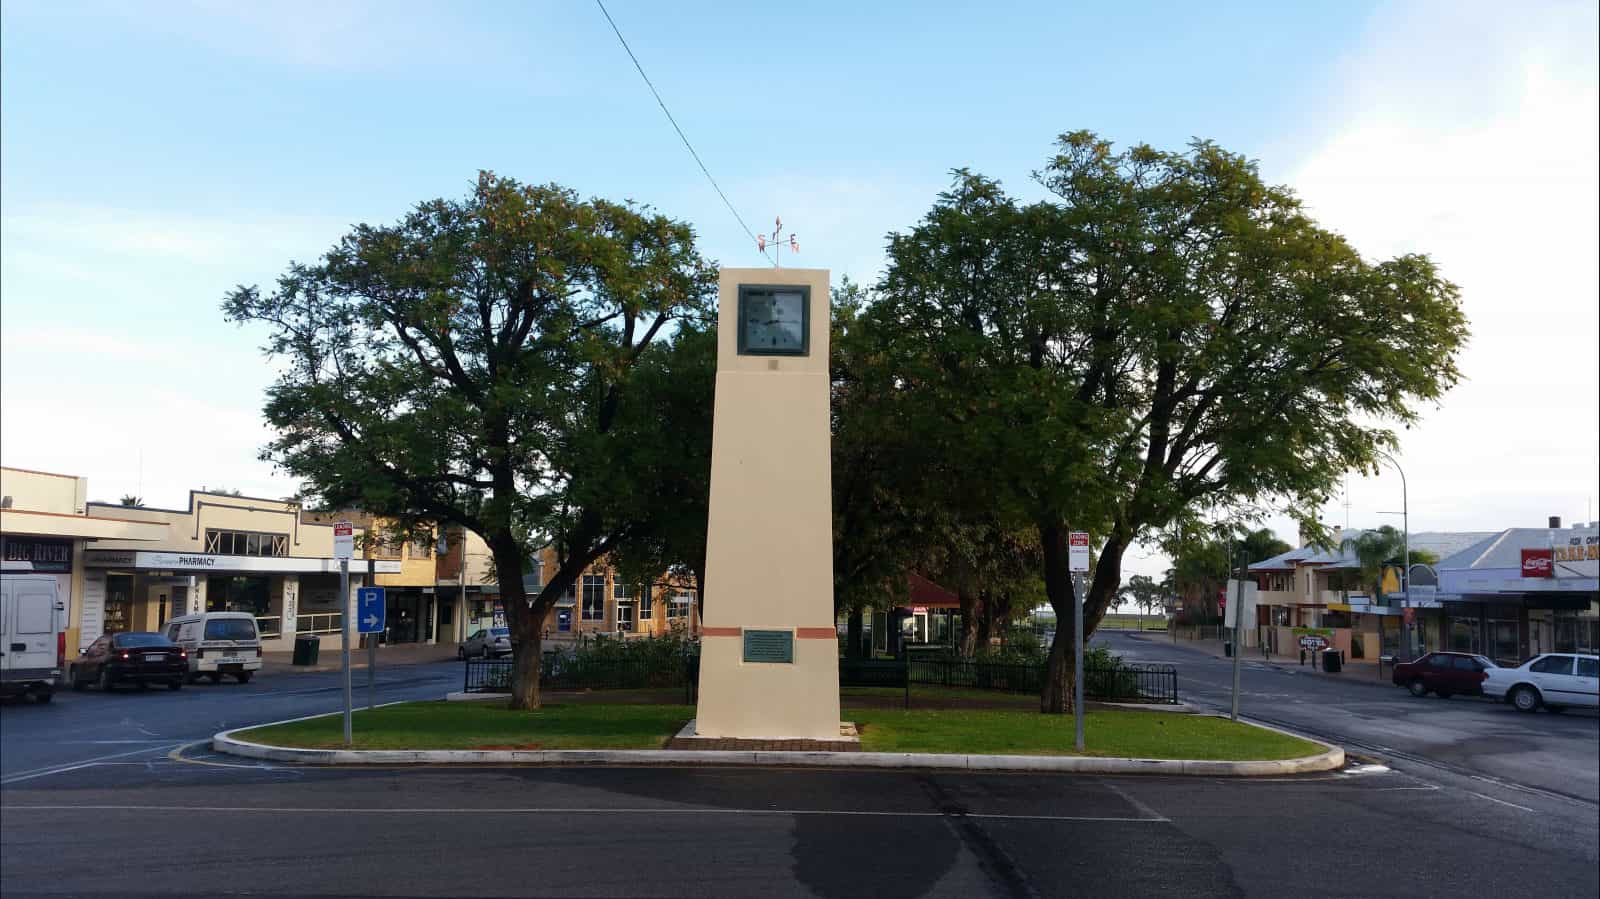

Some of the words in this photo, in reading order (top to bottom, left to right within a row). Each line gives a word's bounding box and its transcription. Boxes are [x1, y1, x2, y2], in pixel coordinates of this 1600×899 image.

[8, 543, 29, 560] BIG
[34, 544, 68, 561] RIVER
[179, 556, 215, 568] PHARMACY
[364, 592, 377, 607] P
